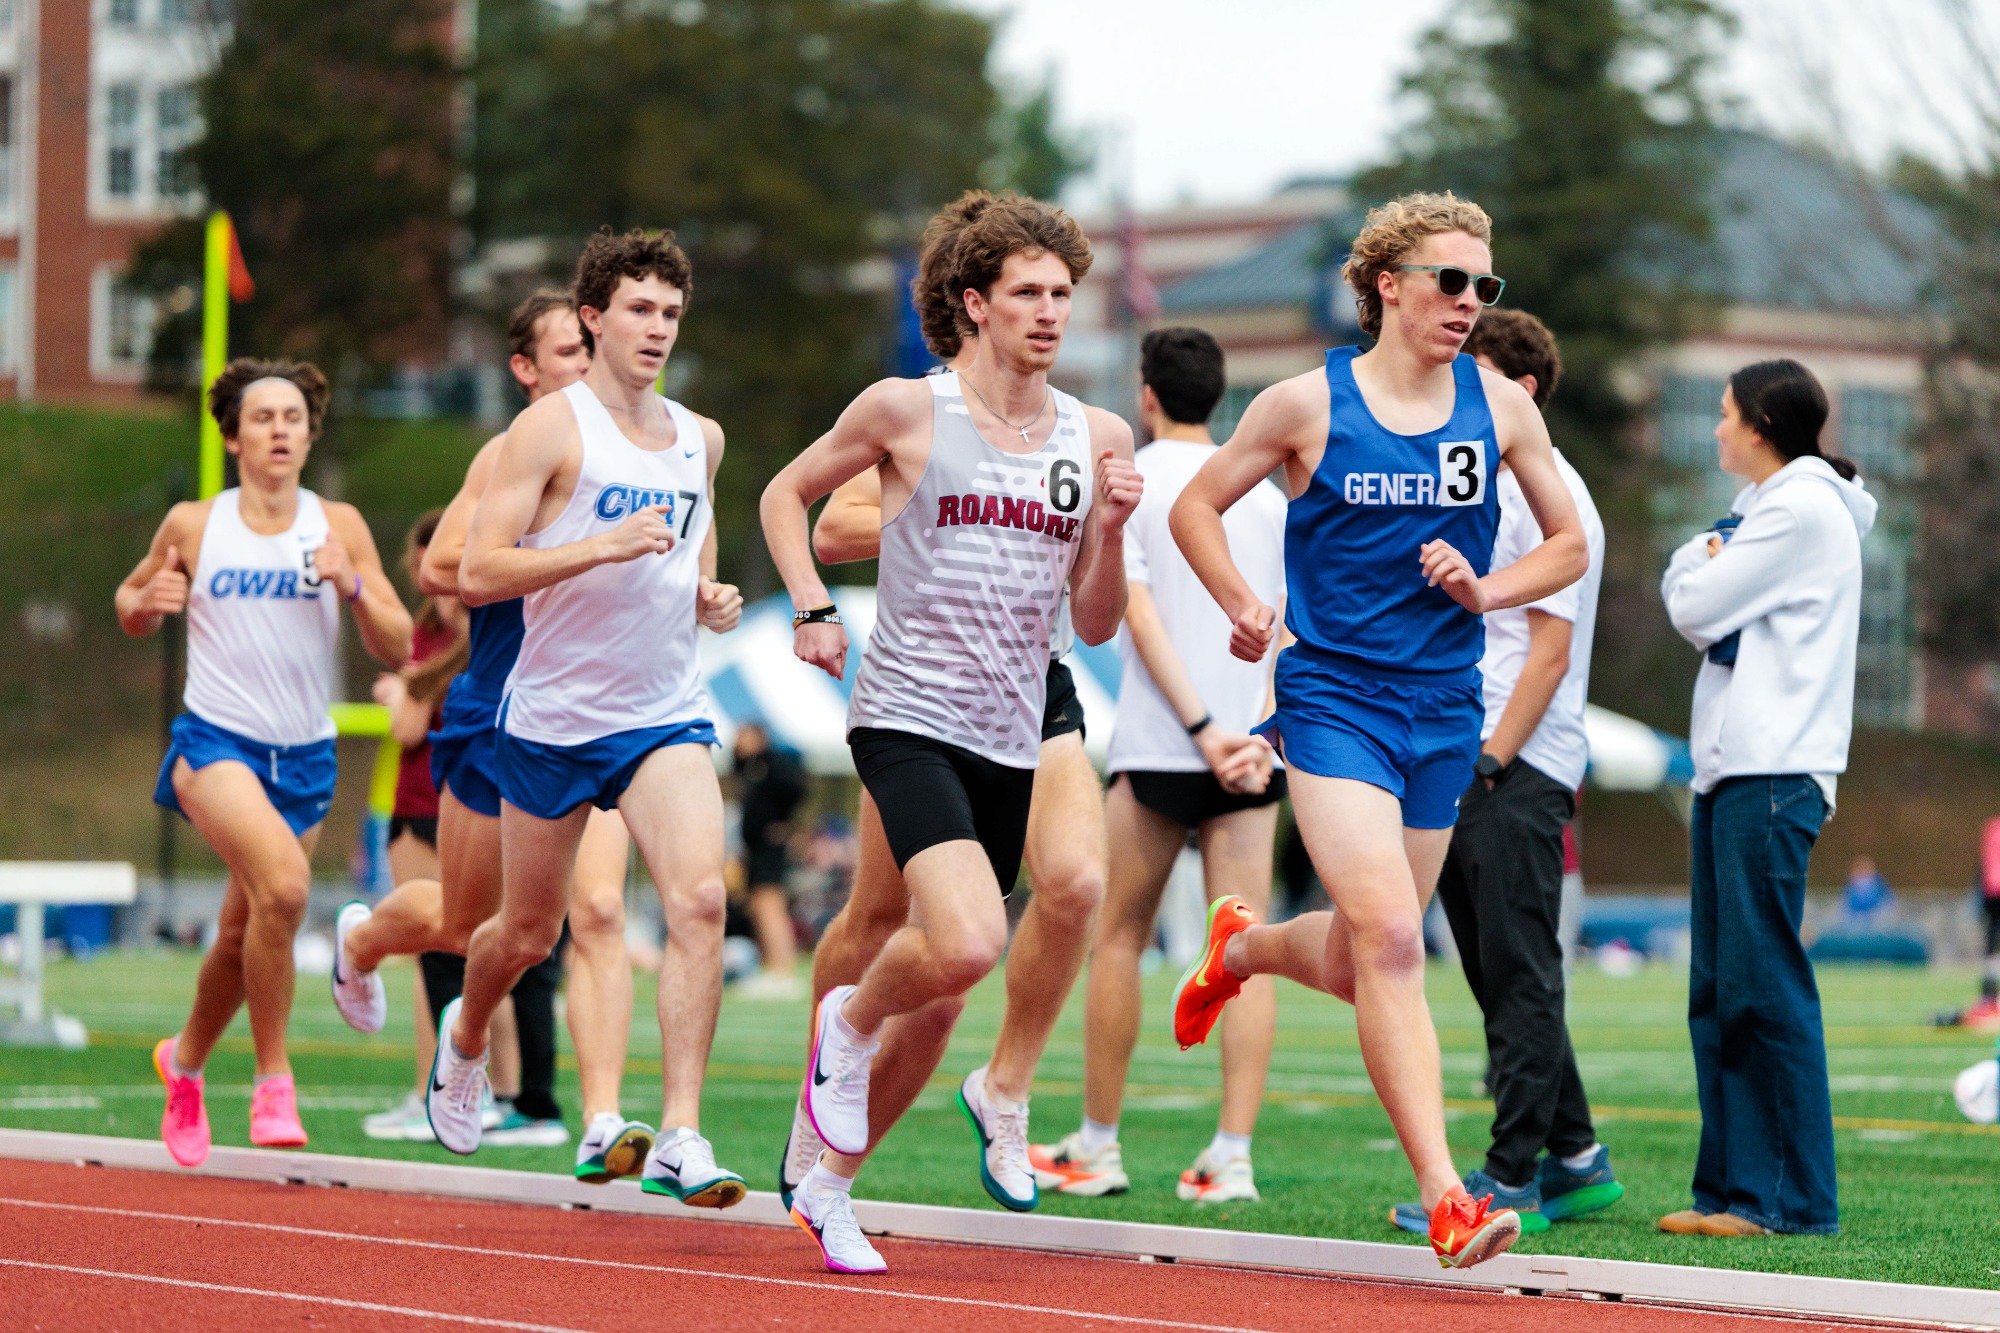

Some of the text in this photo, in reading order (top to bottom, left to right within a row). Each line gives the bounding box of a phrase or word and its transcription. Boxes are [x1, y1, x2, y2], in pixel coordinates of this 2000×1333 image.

[1049, 459, 1081, 513] 6
[1344, 472, 1441, 505] GENER
[1447, 446, 1479, 502] 3
[678, 490, 699, 539] 7
[209, 567, 320, 600] CWR
[304, 551, 322, 587] 5
